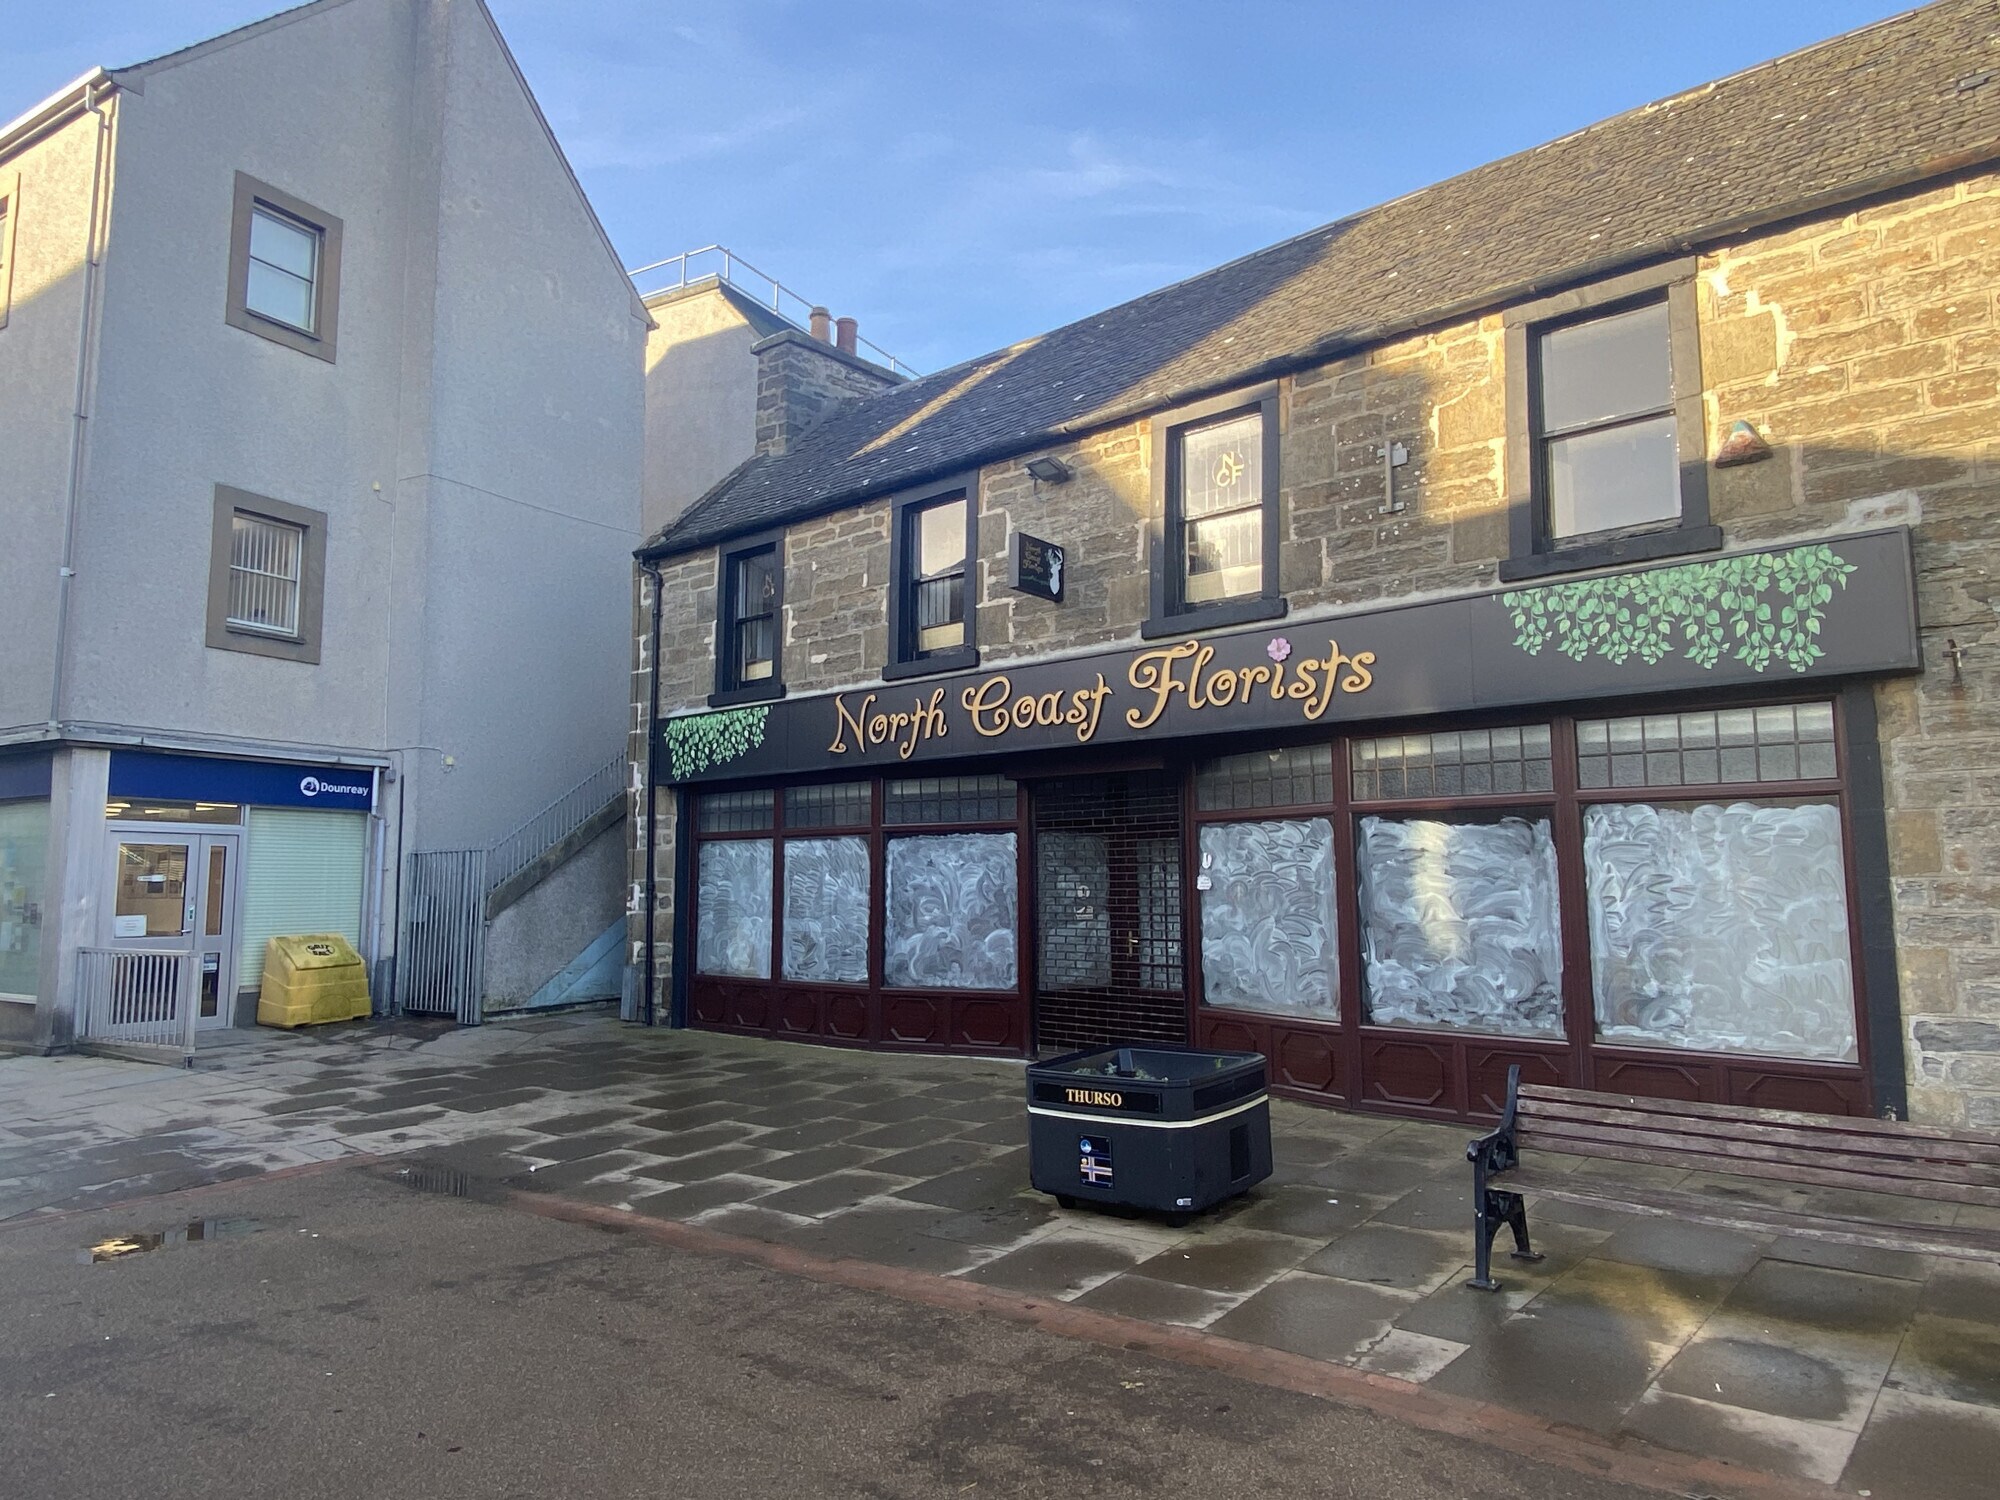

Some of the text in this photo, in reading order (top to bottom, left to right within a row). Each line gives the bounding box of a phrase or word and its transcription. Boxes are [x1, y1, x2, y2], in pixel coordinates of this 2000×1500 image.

[829, 639, 1375, 760] North Coast Florists
[320, 782, 369, 796] Dounreay
[1065, 1088, 1122, 1107] THURSO
